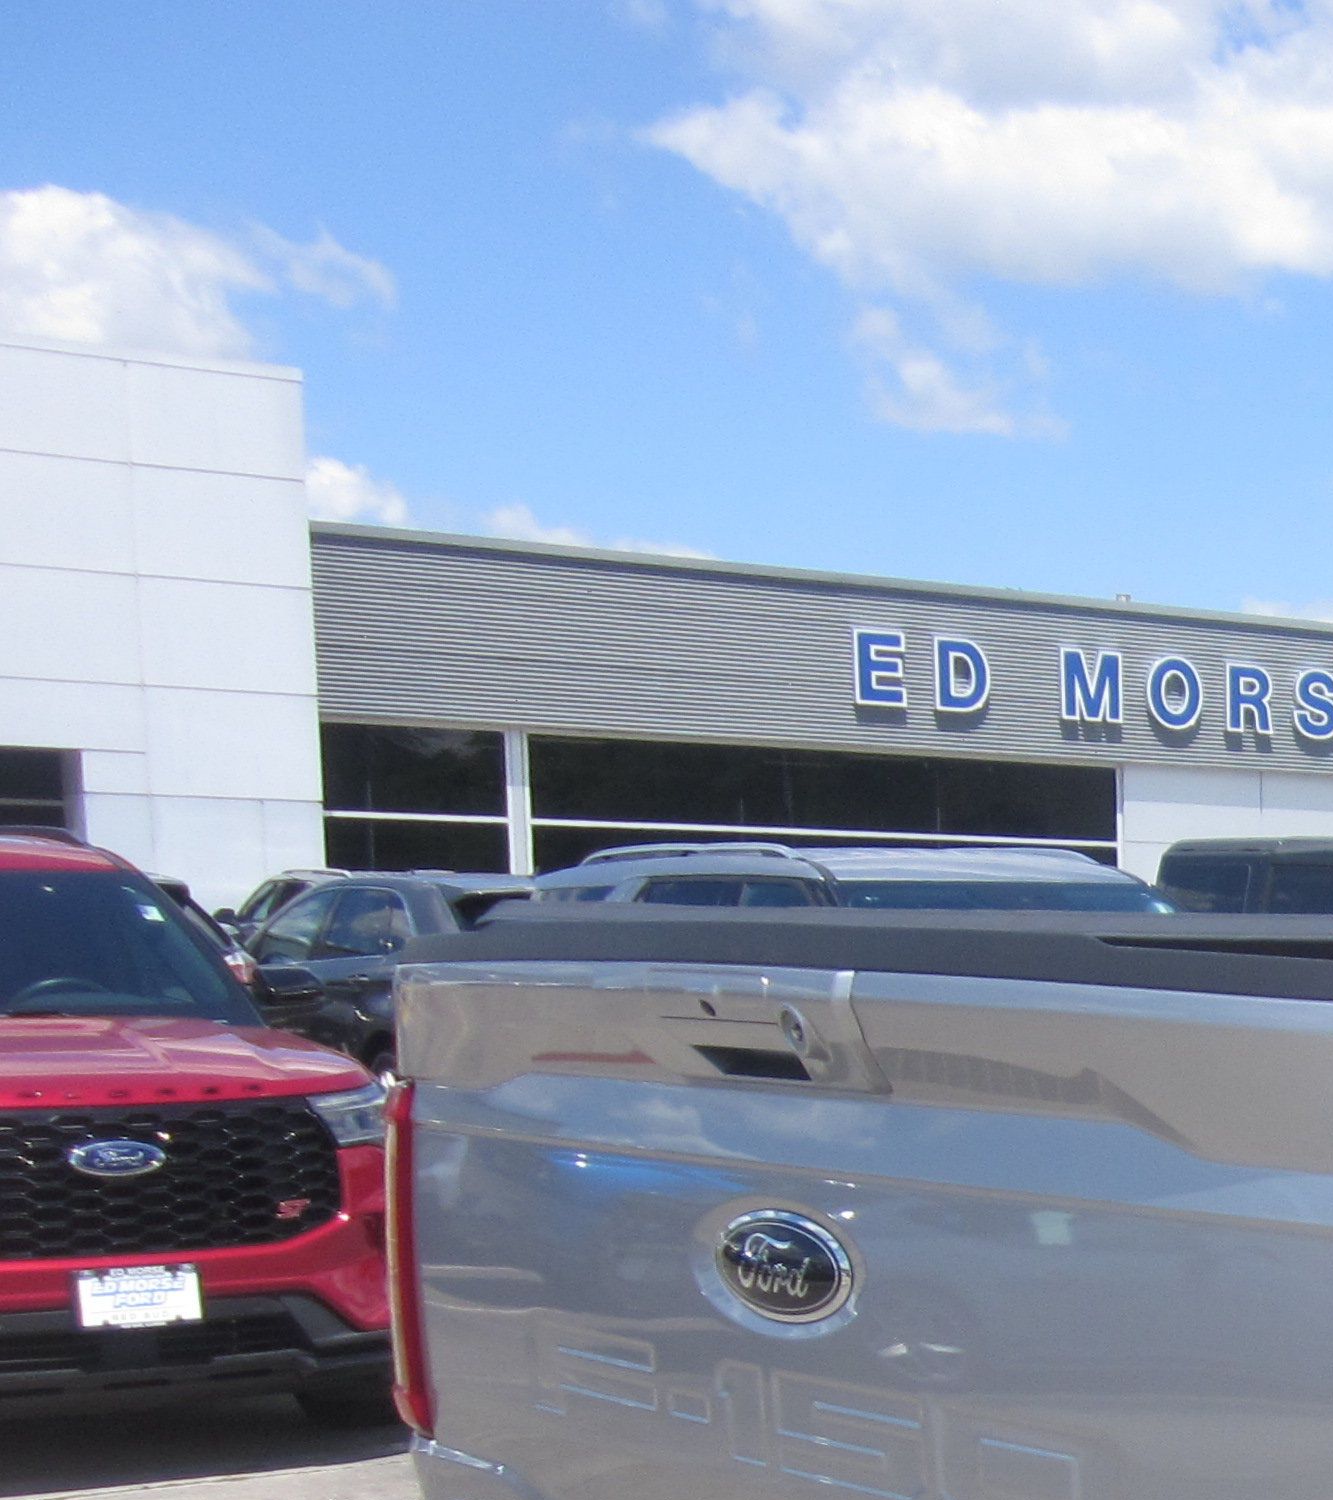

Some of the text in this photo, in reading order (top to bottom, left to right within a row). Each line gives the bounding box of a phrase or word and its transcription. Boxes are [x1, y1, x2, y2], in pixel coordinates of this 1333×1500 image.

[852, 628, 991, 713] ED
[276, 1199, 311, 1219] ST
[91, 1277, 185, 1295] ED MORSE
[113, 1292, 168, 1308] FORD
